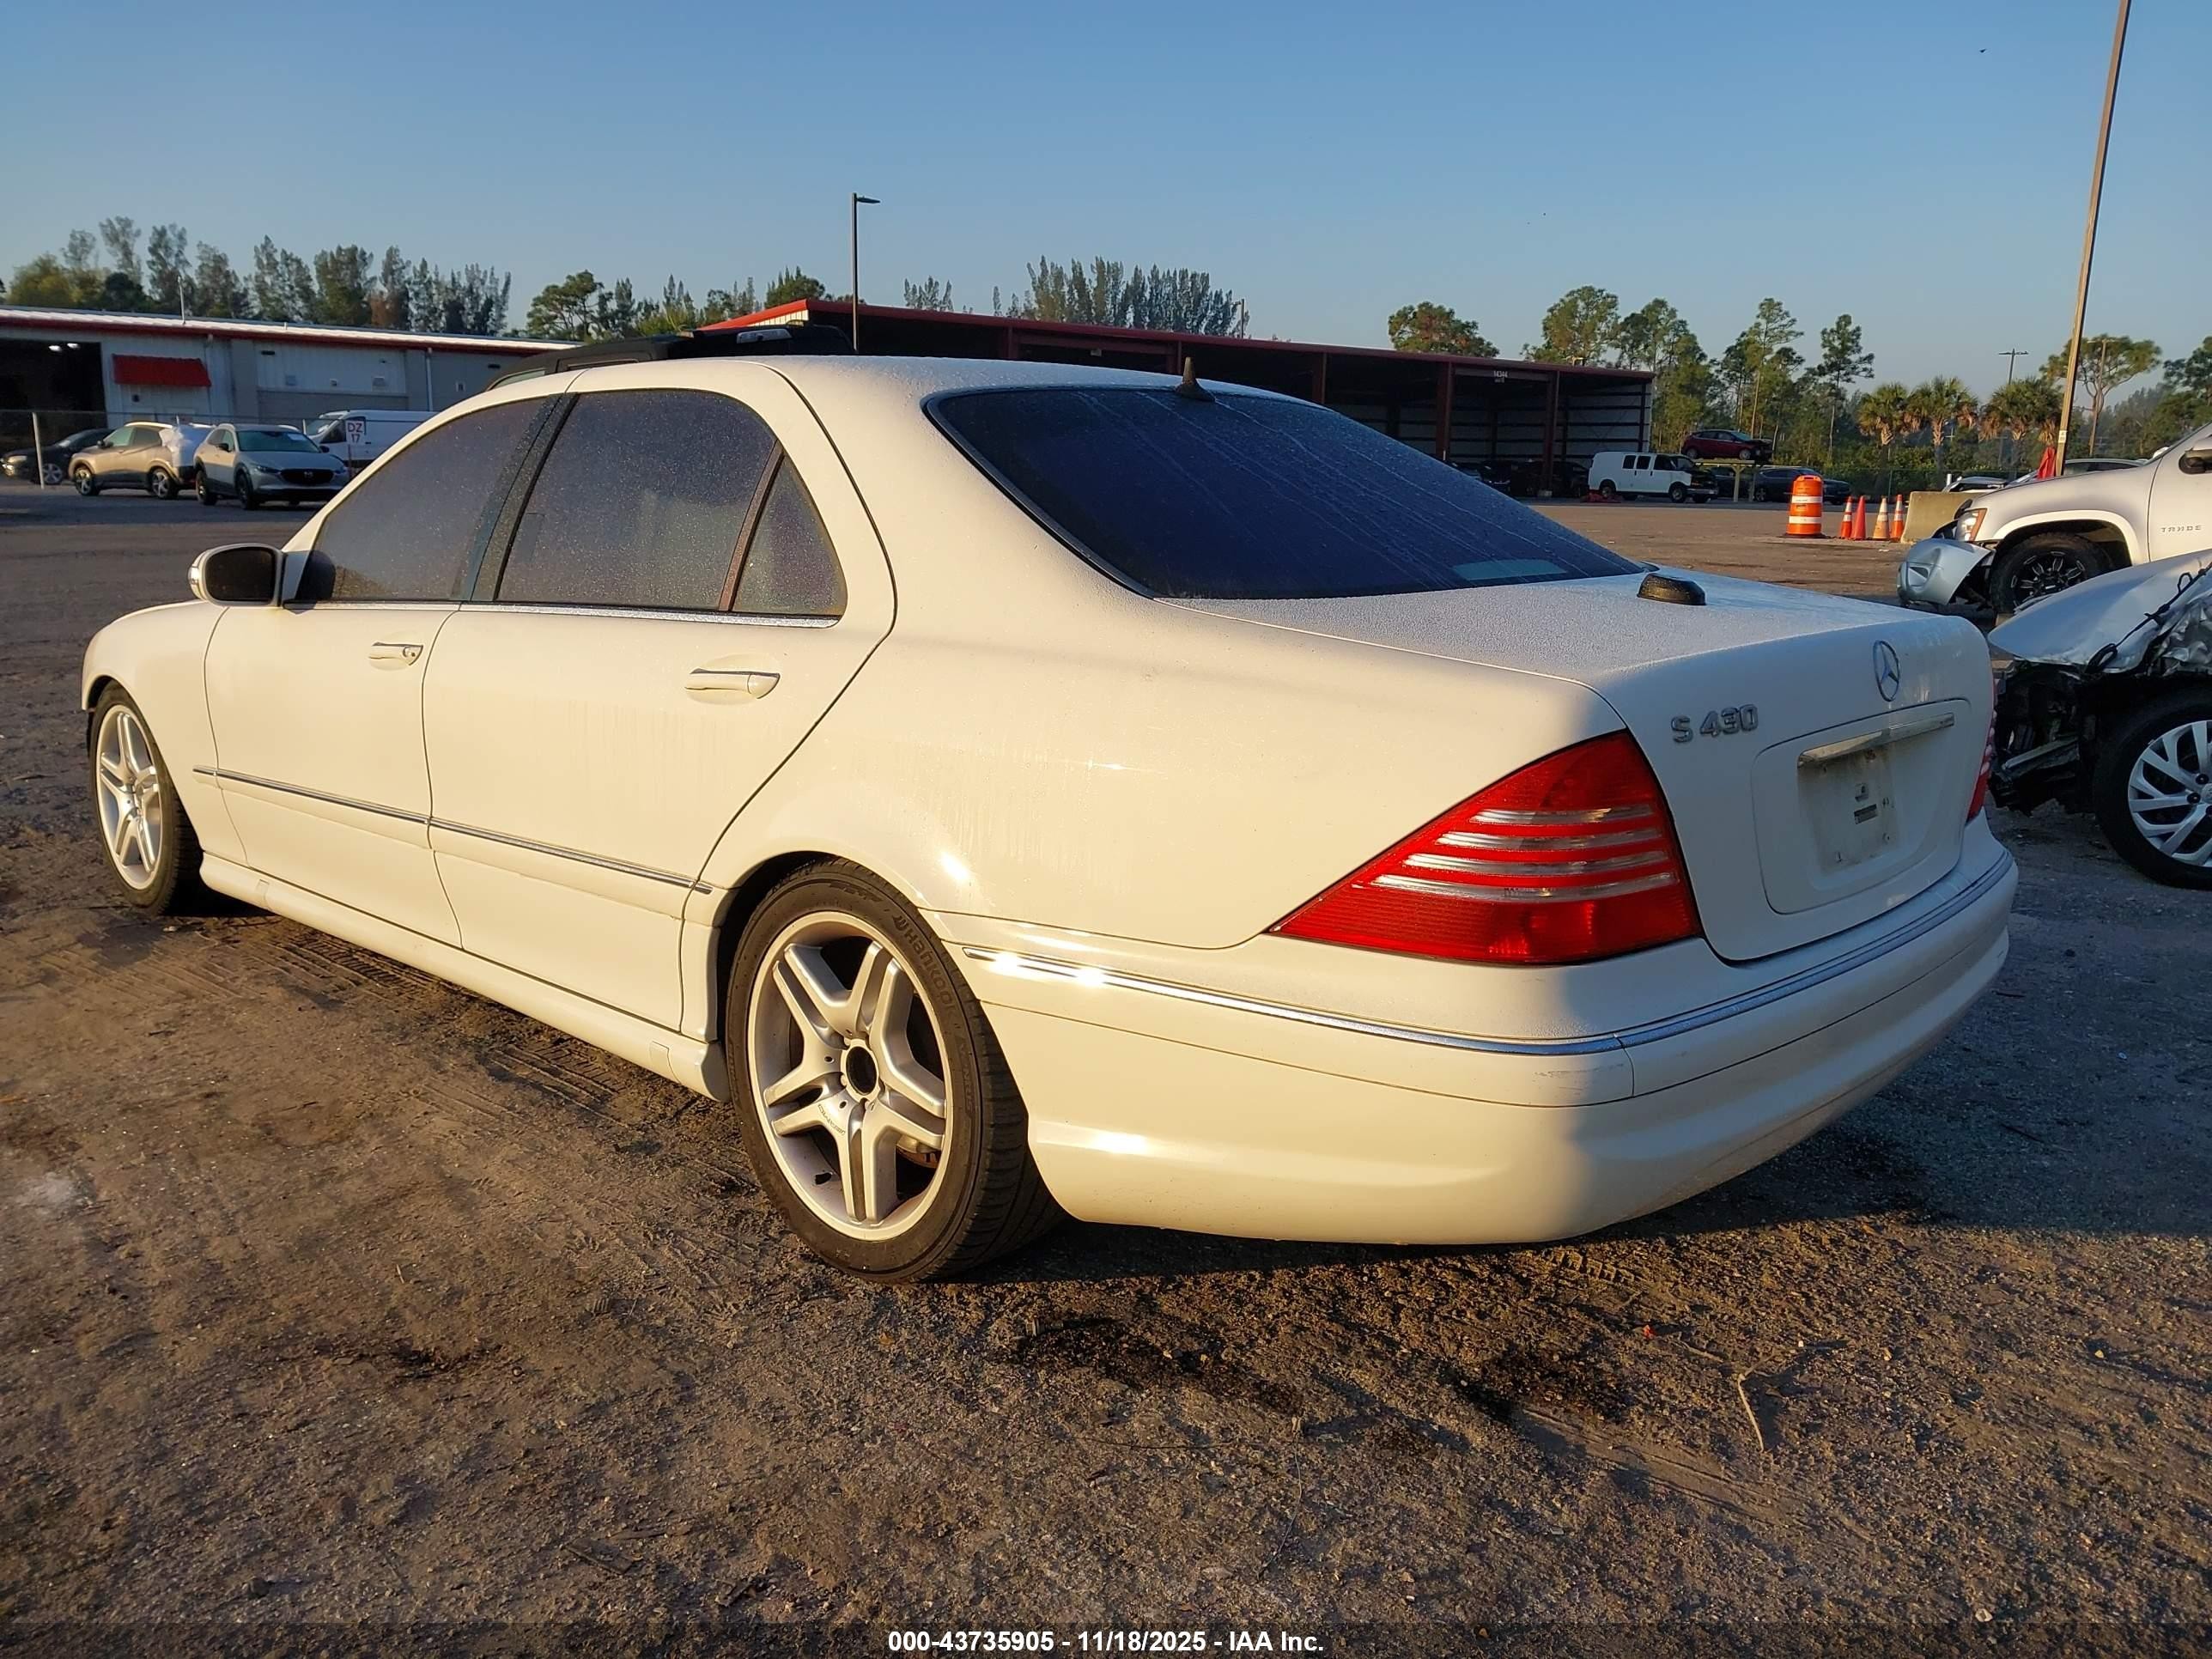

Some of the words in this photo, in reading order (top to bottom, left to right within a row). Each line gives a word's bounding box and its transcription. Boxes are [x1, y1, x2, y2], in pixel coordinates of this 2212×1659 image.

[347, 422, 363, 433] DZ
[351, 433, 361, 443] 17
[1671, 714, 1693, 744] S
[1699, 703, 1759, 738] 430
